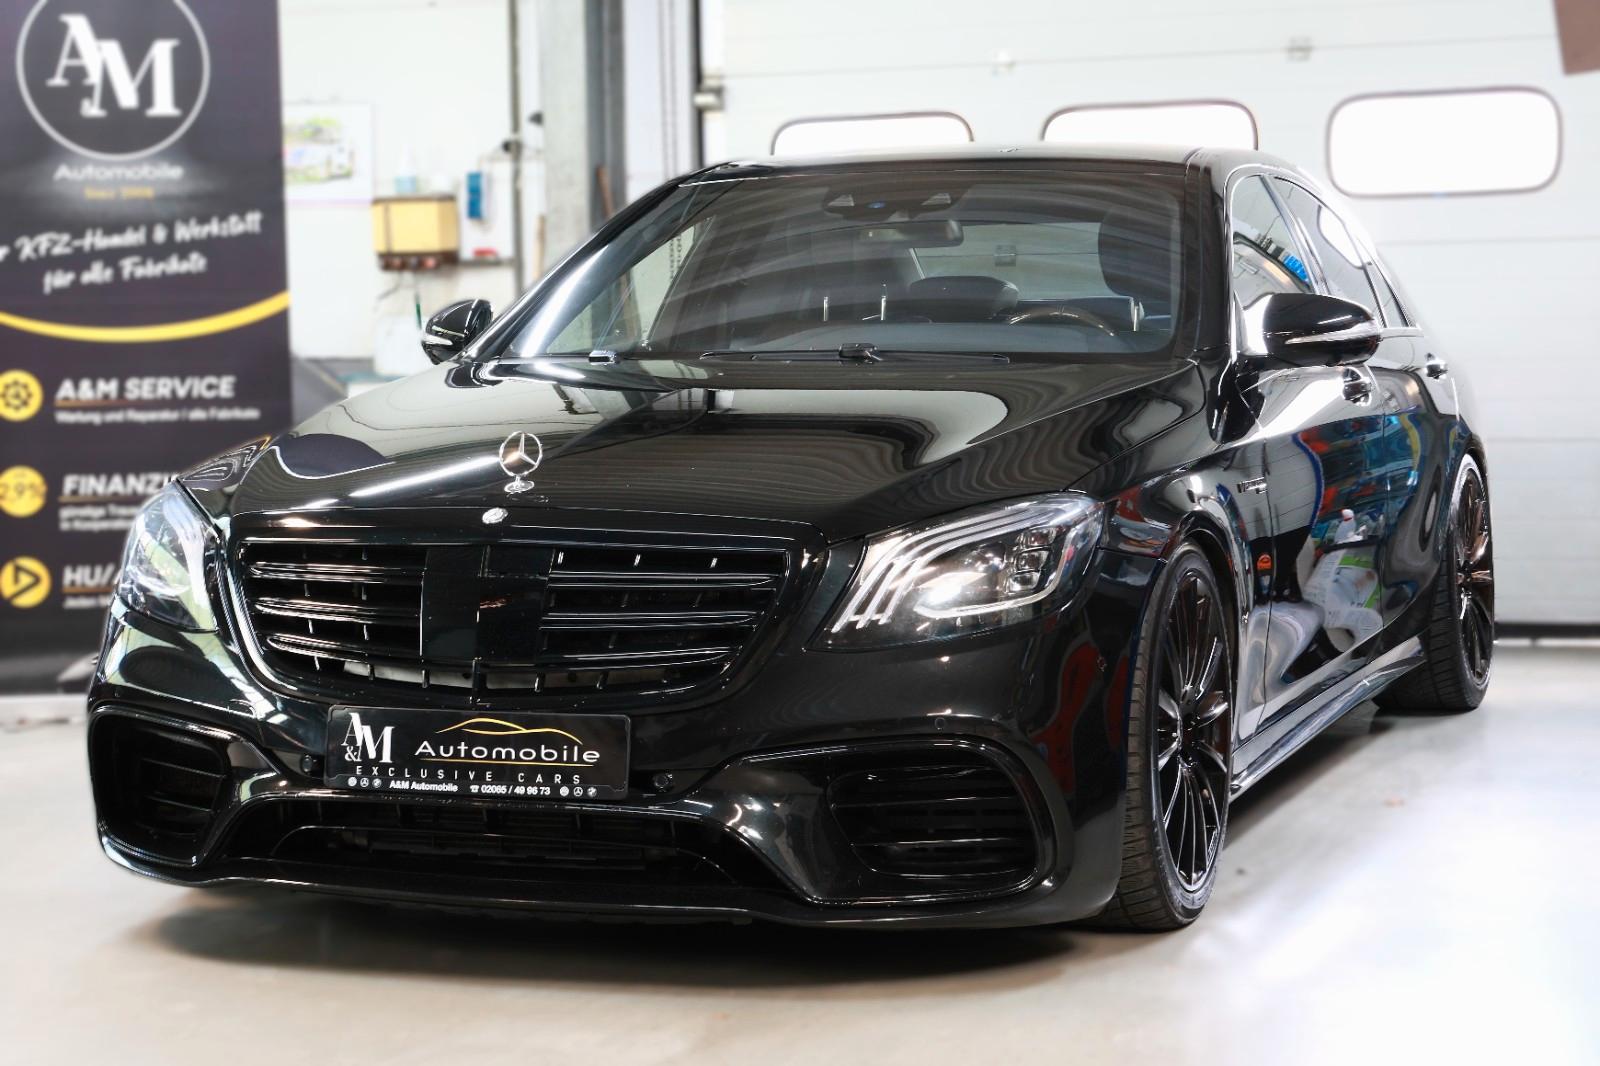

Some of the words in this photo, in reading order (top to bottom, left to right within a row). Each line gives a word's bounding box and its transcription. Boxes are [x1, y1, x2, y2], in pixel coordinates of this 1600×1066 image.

[53, 162, 185, 181] Automobile
[174, 210, 263, 244] Werkstatt
[43, 269, 76, 295] für
[80, 260, 114, 286] alle
[119, 252, 208, 281] Fabrikate
[55, 377, 119, 401] A&M
[124, 374, 237, 400] SERVICE
[414, 740, 601, 764] Automobile
[355, 765, 494, 782] EXCLUSIVE
[517, 773, 582, 785] CARS
[389, 779, 410, 790] A&M
[410, 780, 459, 793] Automobile
[513, 785, 527, 795] 49
[526, 786, 539, 796] 96
[539, 786, 552, 796] 73
